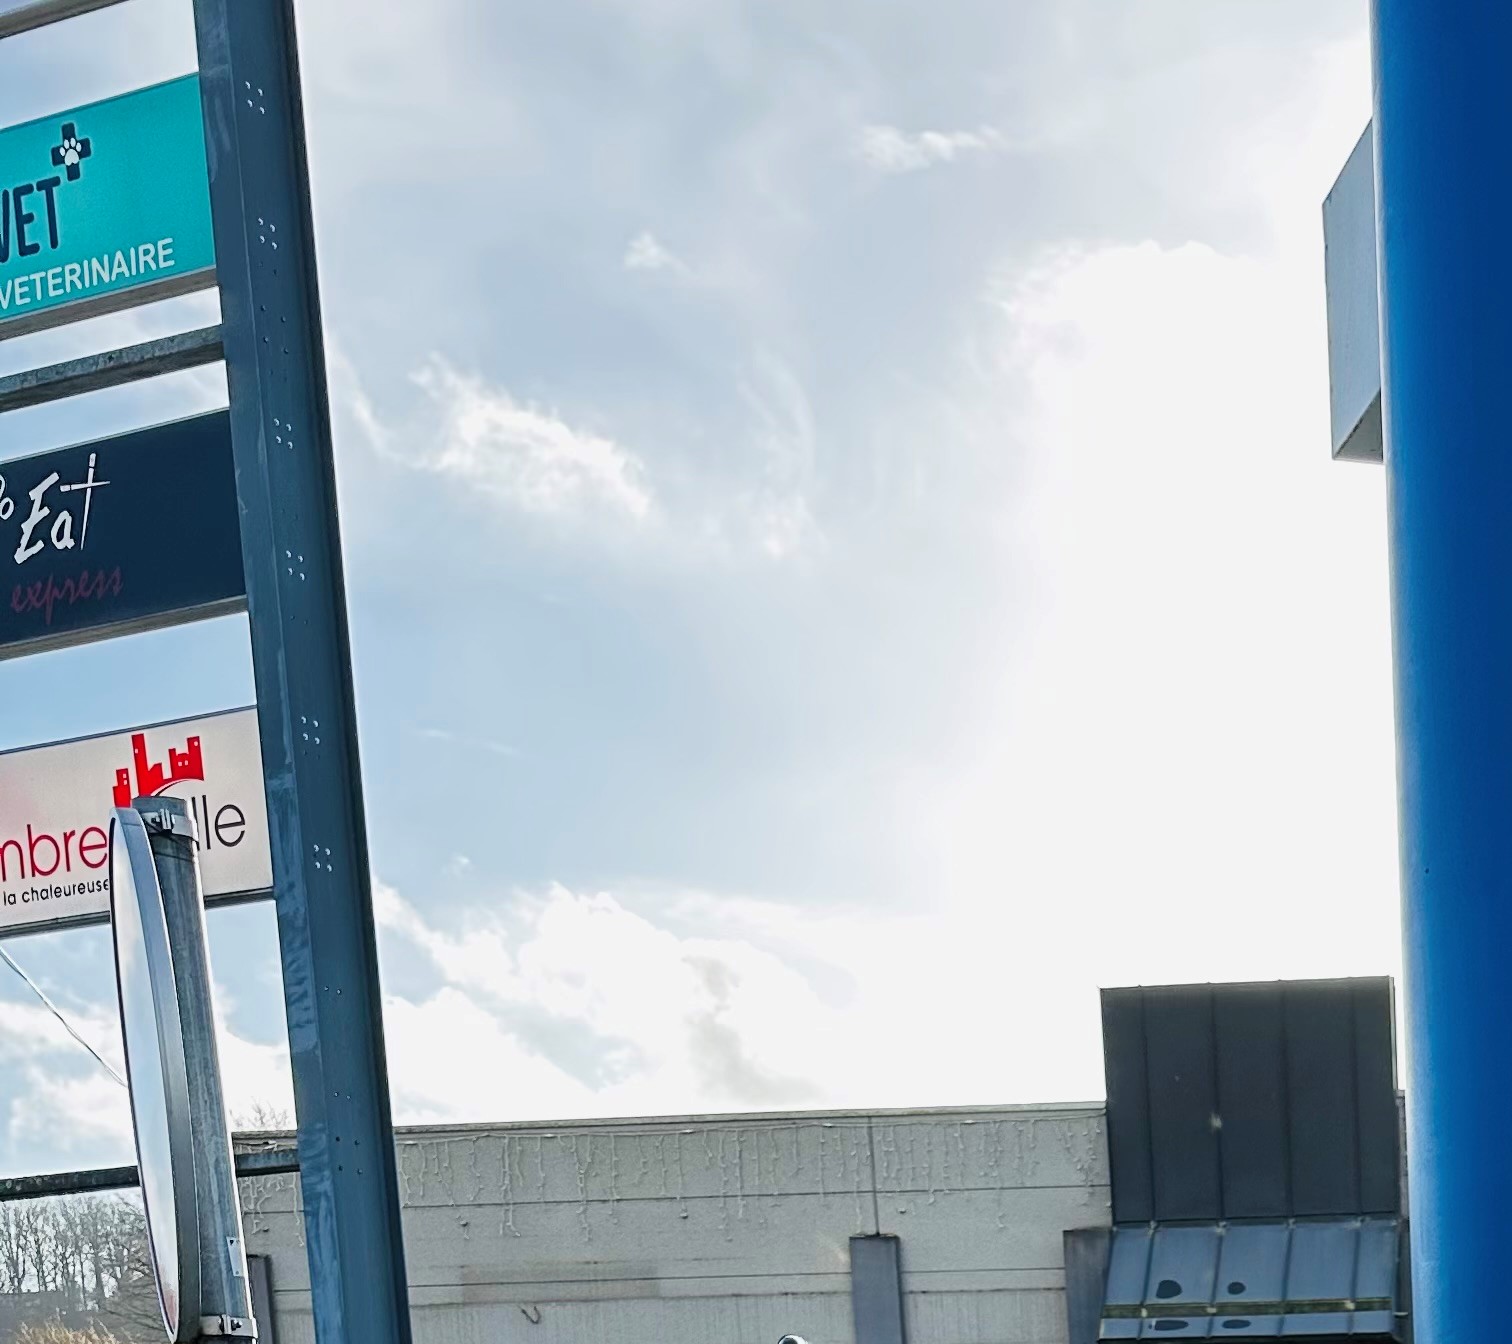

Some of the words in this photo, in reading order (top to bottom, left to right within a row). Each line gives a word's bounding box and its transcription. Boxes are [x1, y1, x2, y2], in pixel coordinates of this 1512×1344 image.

[0, 238, 175, 310] VETERINAIRE
[14, 453, 111, 564] Eat
[10, 566, 123, 625] express
[3, 891, 16, 906] la
[22, 878, 109, 903] chaleureuse
